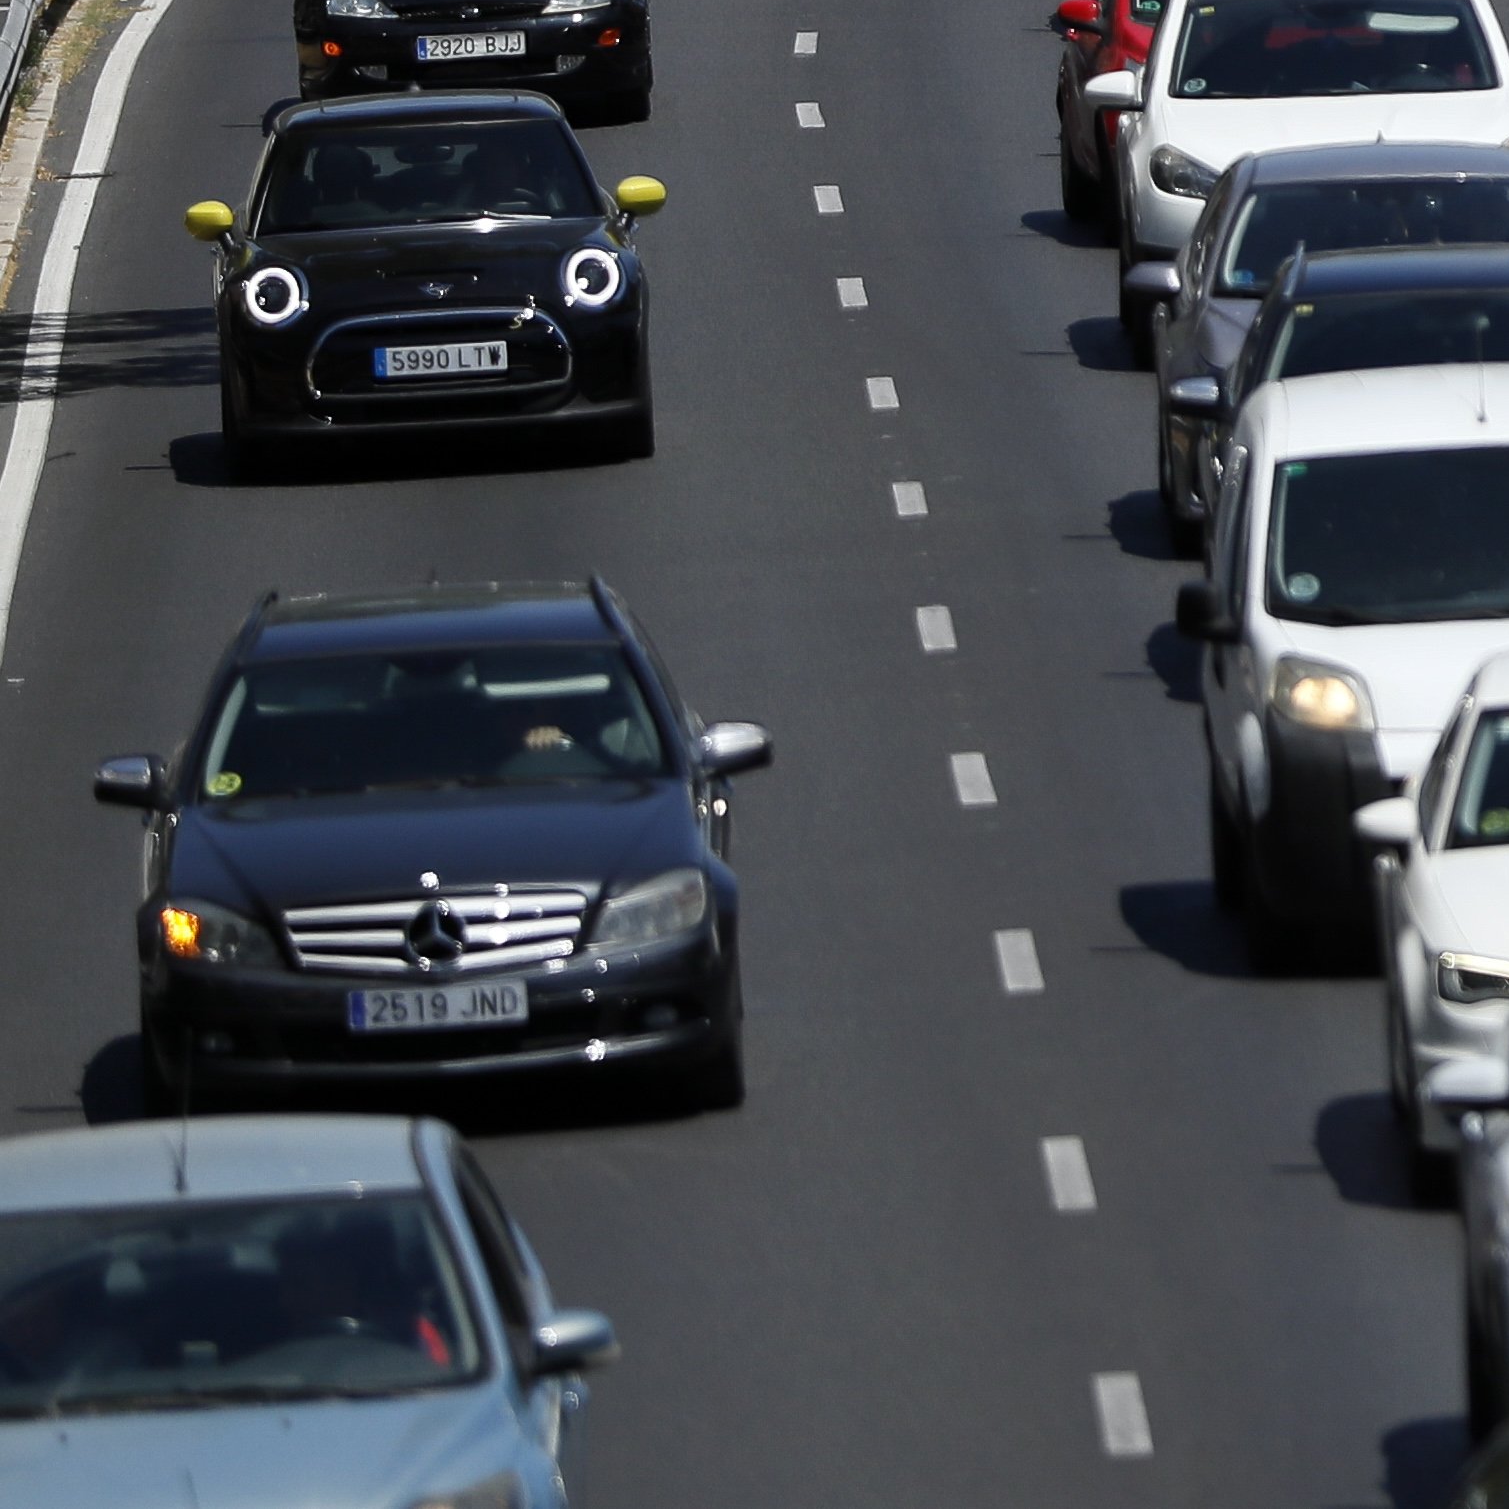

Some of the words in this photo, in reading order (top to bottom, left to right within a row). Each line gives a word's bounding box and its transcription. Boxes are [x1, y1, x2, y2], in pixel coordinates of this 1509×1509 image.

[429, 38, 476, 58] 2920
[485, 35, 522, 55] BJJ
[391, 348, 450, 372] 5990
[458, 345, 507, 370] LTW
[371, 992, 448, 1026] 2519
[460, 986, 520, 1020] JND
